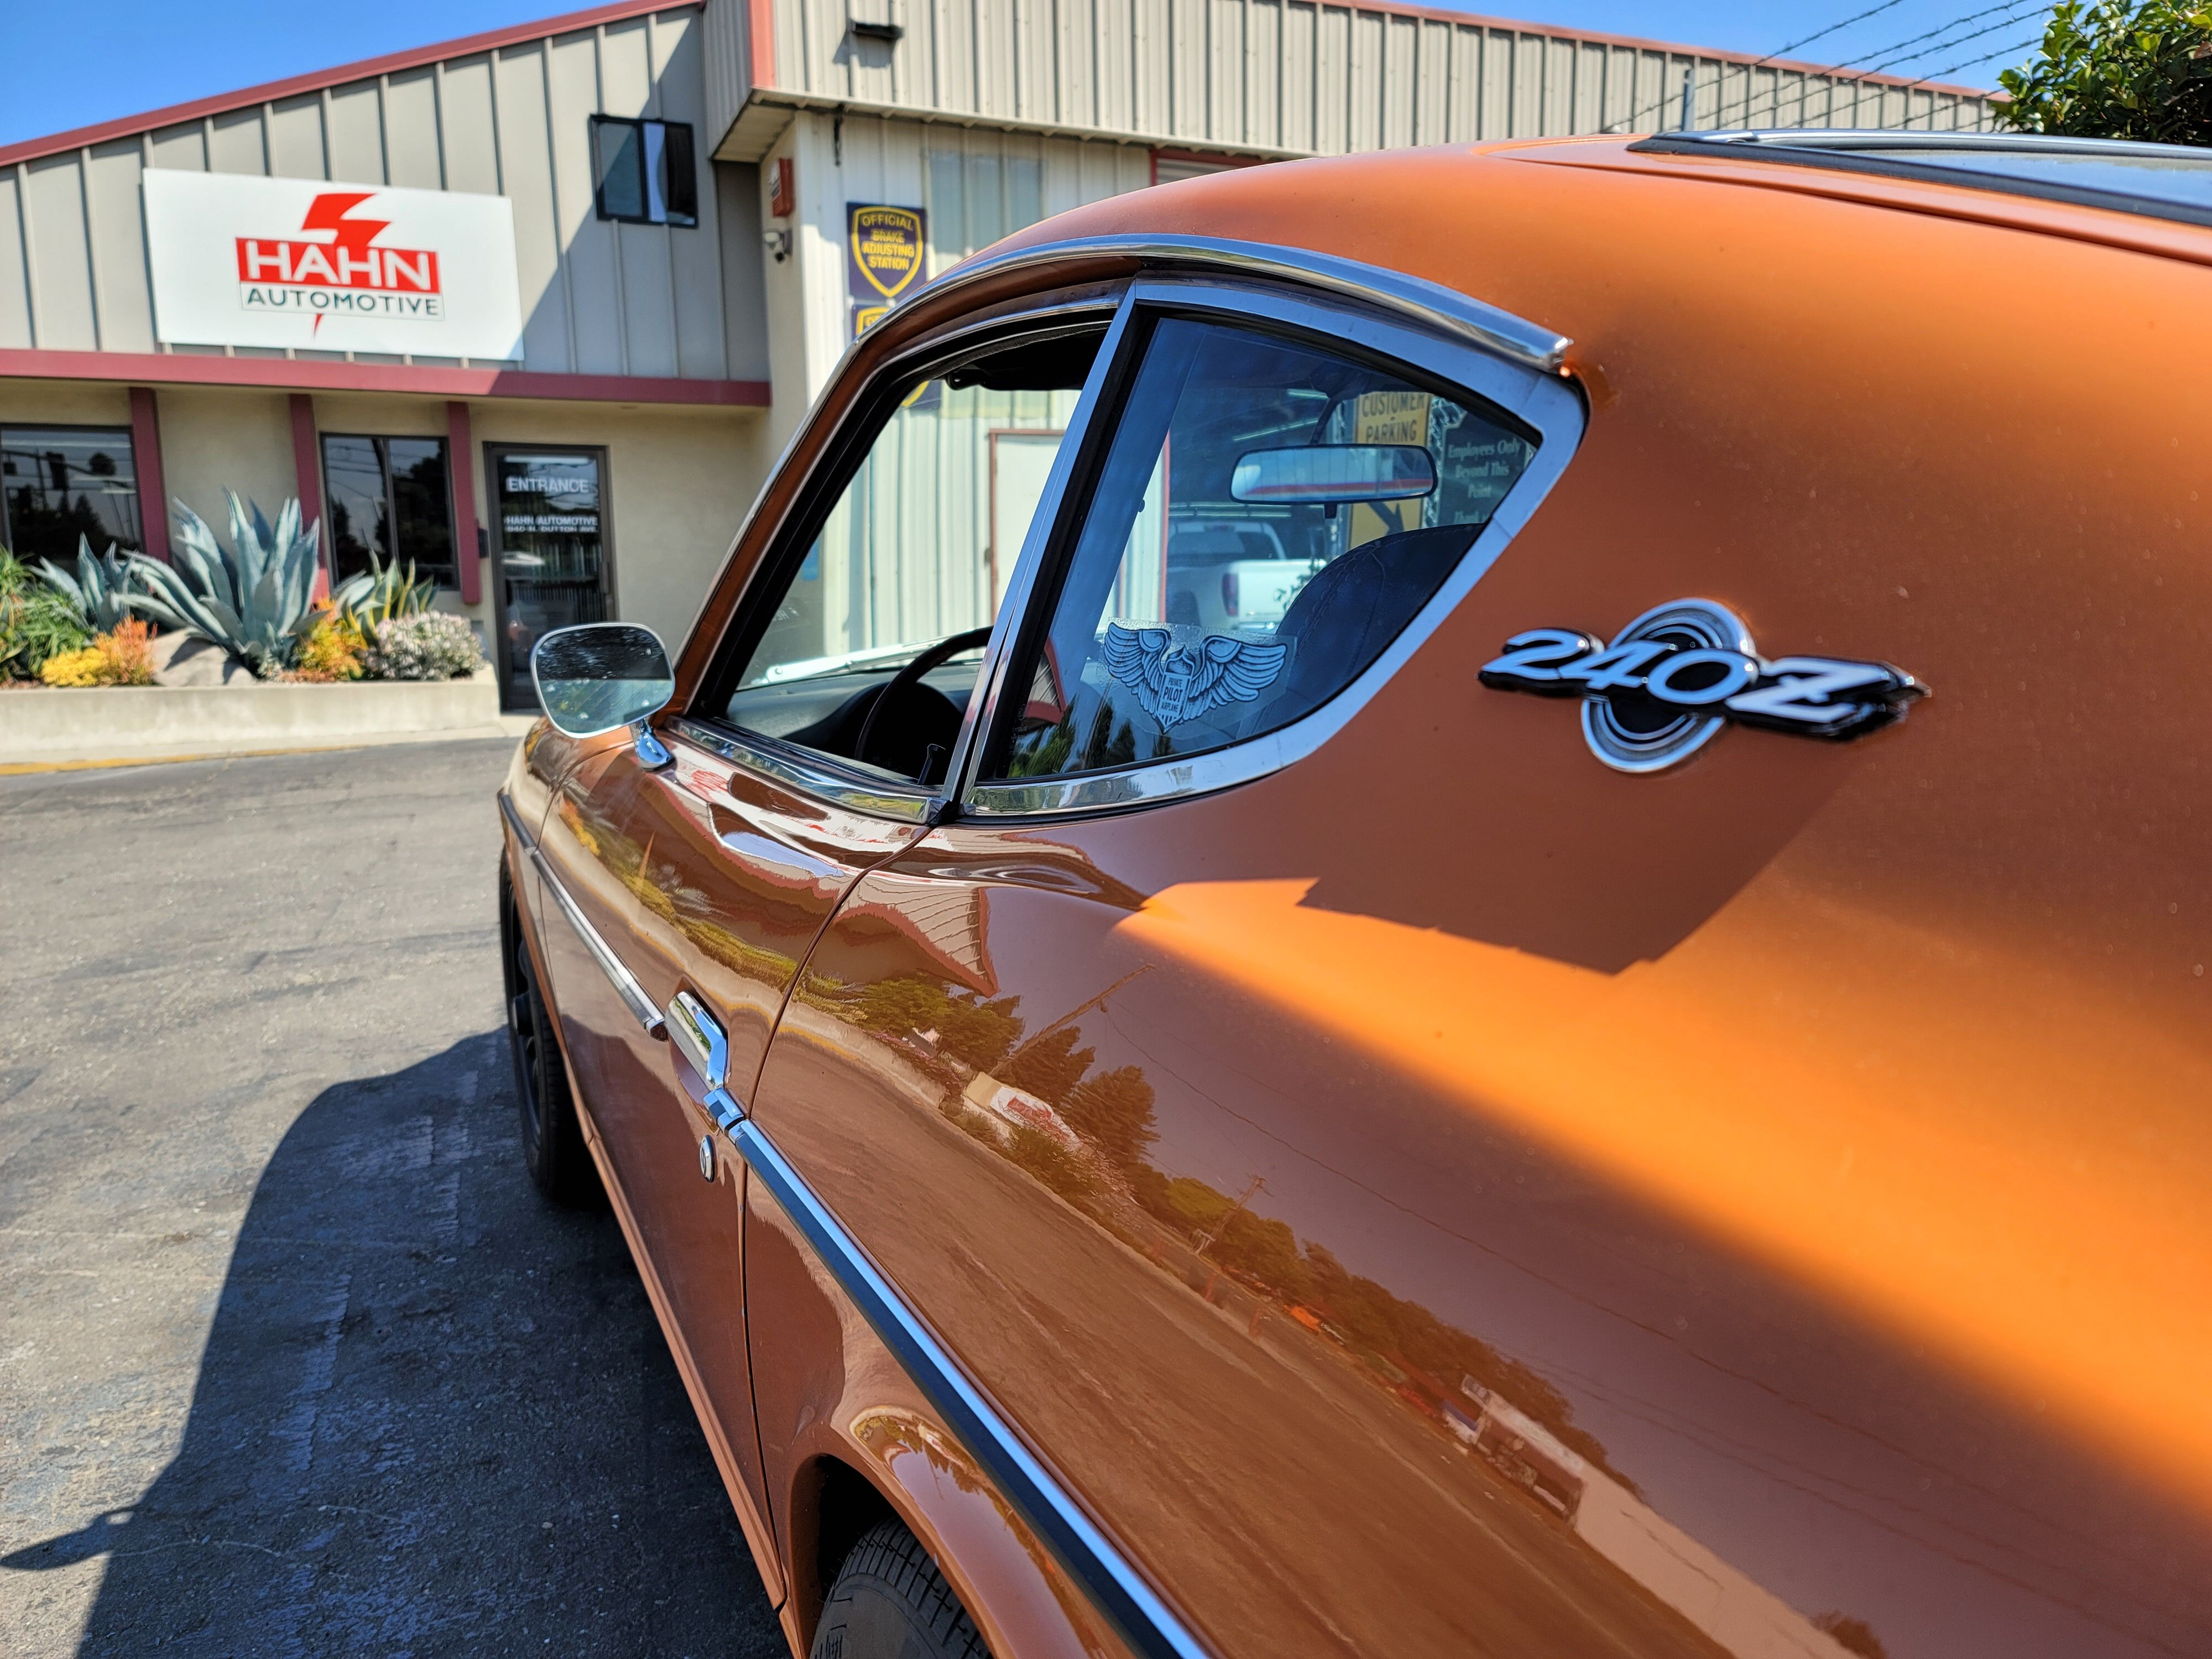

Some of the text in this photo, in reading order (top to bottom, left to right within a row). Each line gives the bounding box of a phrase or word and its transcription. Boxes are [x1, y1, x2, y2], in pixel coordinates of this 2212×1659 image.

[862, 214, 914, 230] OFFICIAL
[872, 229, 905, 243] BRAKE
[861, 241, 915, 257] ADJUSTING
[246, 239, 432, 291] HAHN
[868, 254, 910, 270] STATION
[248, 288, 440, 316] AUTOMOTIVE
[1363, 392, 1425, 417] CUSTOMER
[1365, 419, 1417, 443] PARKING
[1448, 438, 1520, 461] Employees Only
[1491, 461, 1510, 476] This
[506, 476, 589, 493] ENTRANCE
[1468, 483, 1491, 499] Point
[505, 515, 598, 525] HAHN AUTOMOTIVE
[1168, 677, 1183, 688] PRIVATE
[1163, 686, 1183, 703] PILOT
[1161, 702, 1179, 713] AIRPLANE
